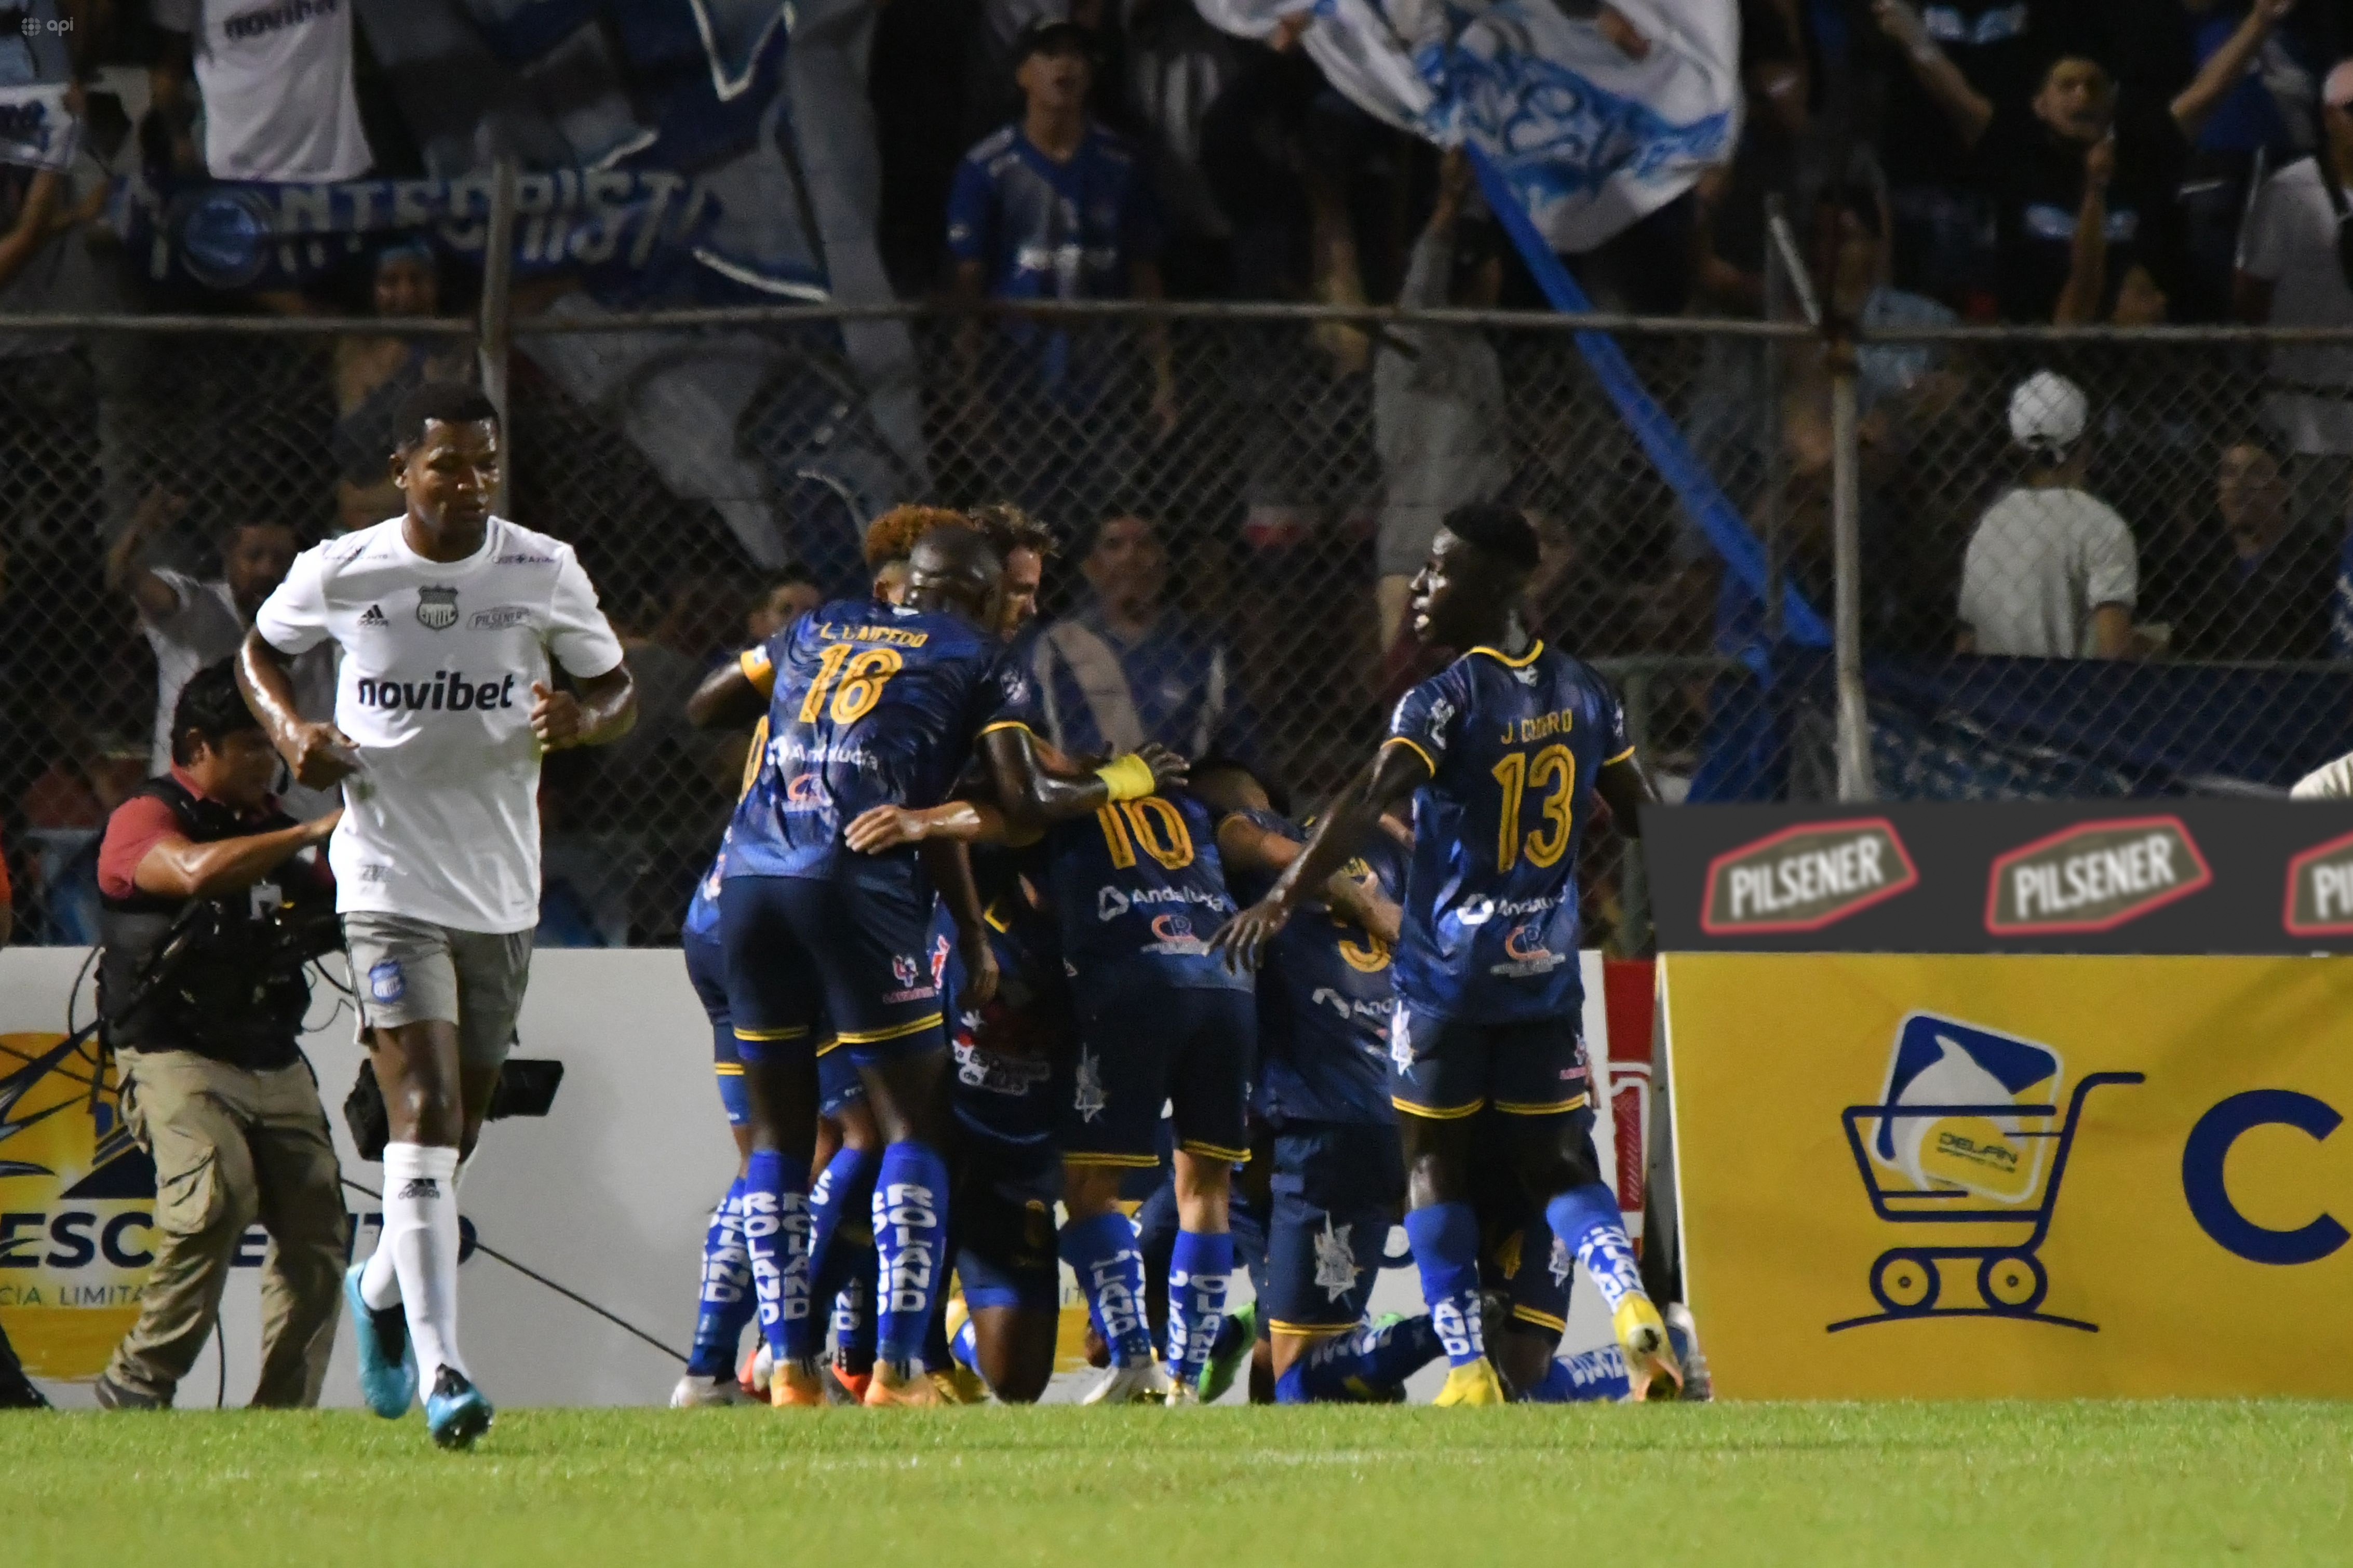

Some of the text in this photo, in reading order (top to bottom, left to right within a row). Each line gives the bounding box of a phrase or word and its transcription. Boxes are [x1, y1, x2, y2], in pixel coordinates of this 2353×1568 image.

[358, 670, 515, 711] novibet
[1096, 796, 1195, 871] 10
[1492, 742, 1576, 874] 13
[1728, 834, 1884, 919] PILSENER
[2013, 832, 2176, 919] PILSENER
[2182, 1088, 2351, 1266] C
[886, 1183, 937, 1313] ROLAND
[60, 1285, 143, 1305] LIMITA
